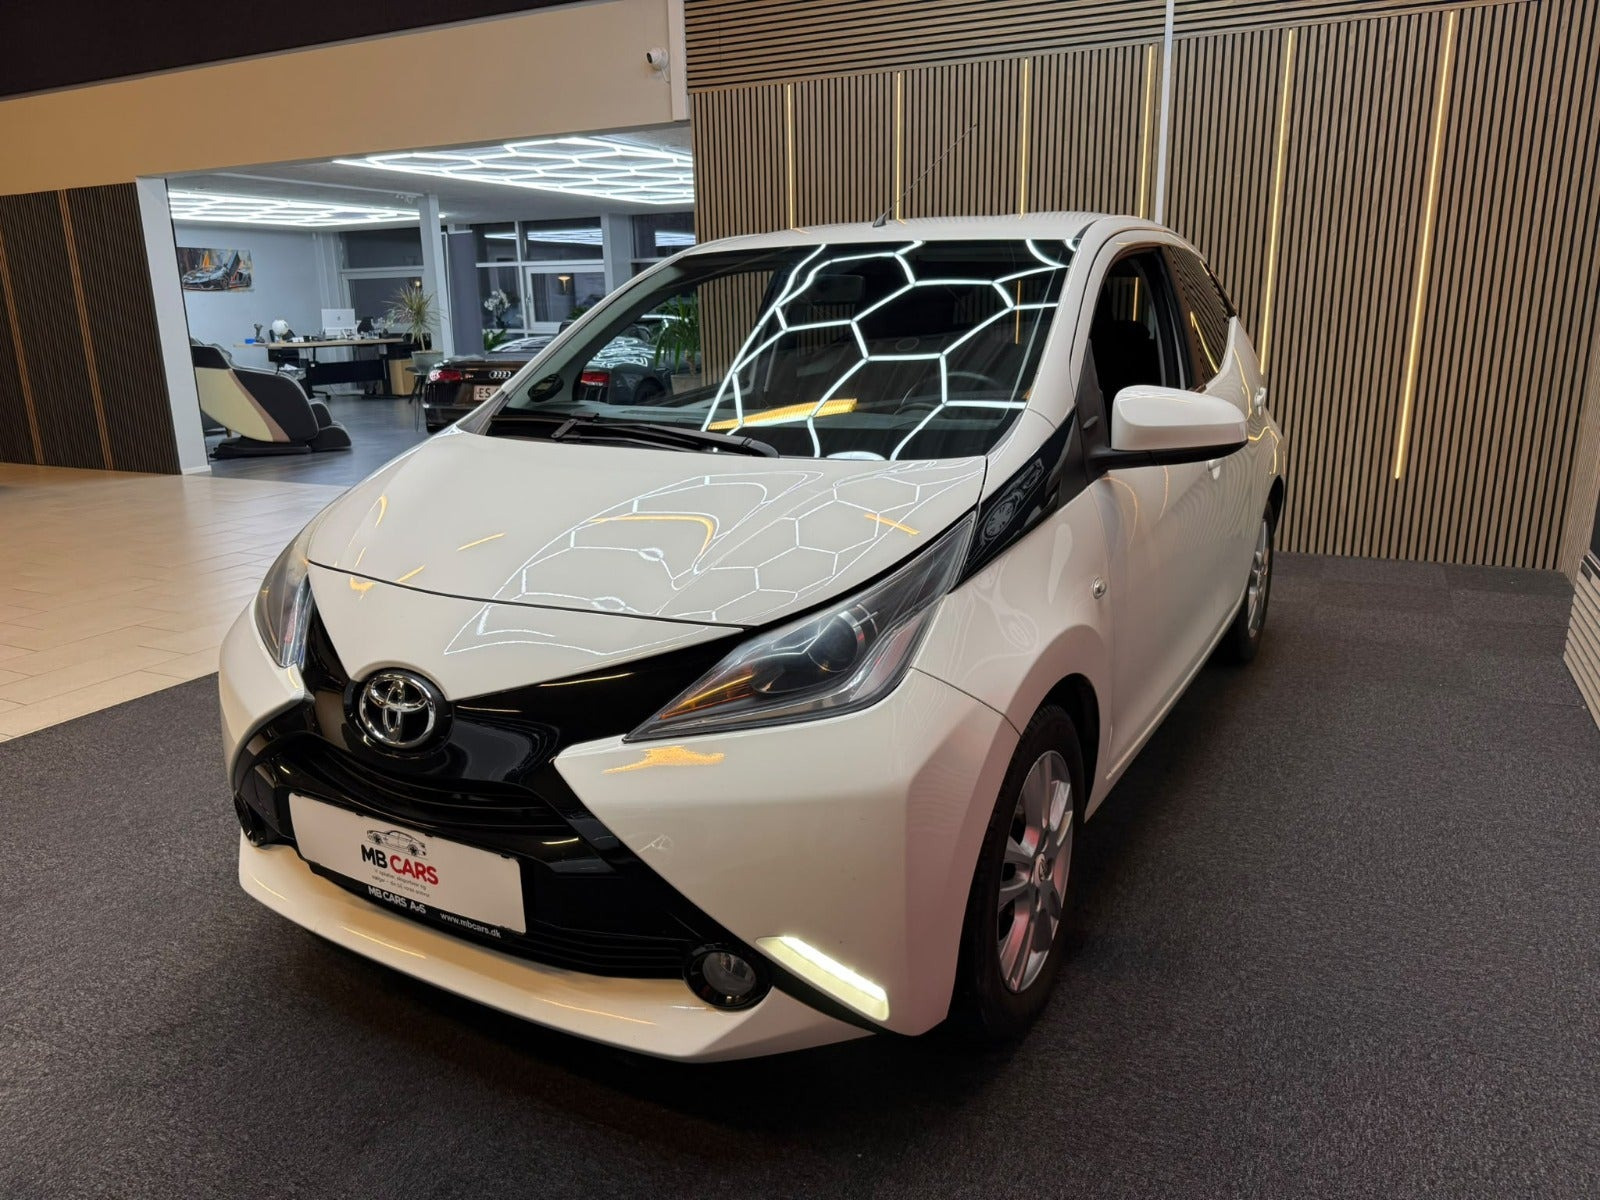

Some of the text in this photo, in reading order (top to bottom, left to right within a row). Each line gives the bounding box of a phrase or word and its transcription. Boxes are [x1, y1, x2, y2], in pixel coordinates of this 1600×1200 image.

[479, 387, 491, 398] ES
[361, 844, 388, 869] MB
[389, 854, 439, 885] CARS
[368, 886, 383, 900] MB
[382, 891, 407, 908] CARS
[440, 912, 502, 939] www.mbcars.dk
